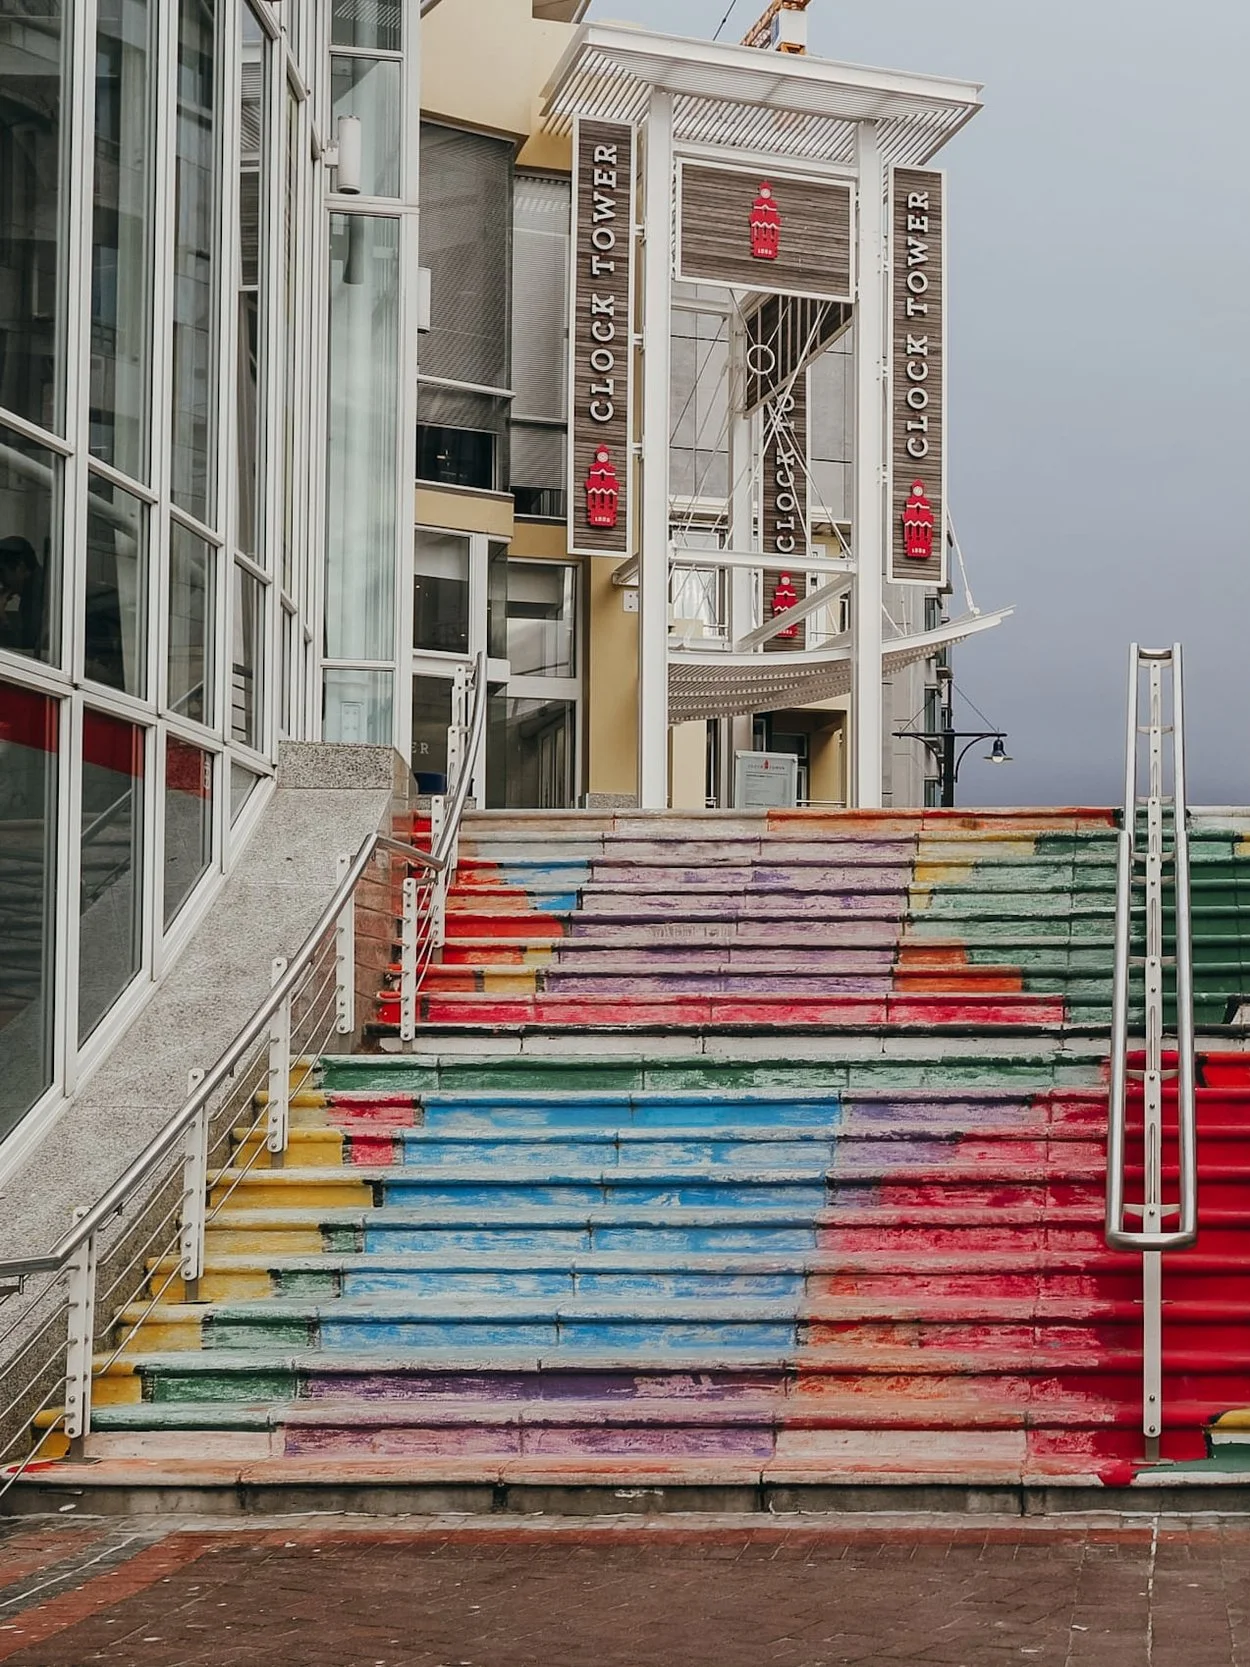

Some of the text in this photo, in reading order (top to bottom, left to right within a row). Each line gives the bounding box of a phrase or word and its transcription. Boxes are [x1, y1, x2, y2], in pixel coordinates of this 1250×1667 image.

[589, 144, 617, 422] CLOCK TOWER
[906, 190, 929, 459] CLOCK TOWER
[776, 447, 795, 553] CLOCK
